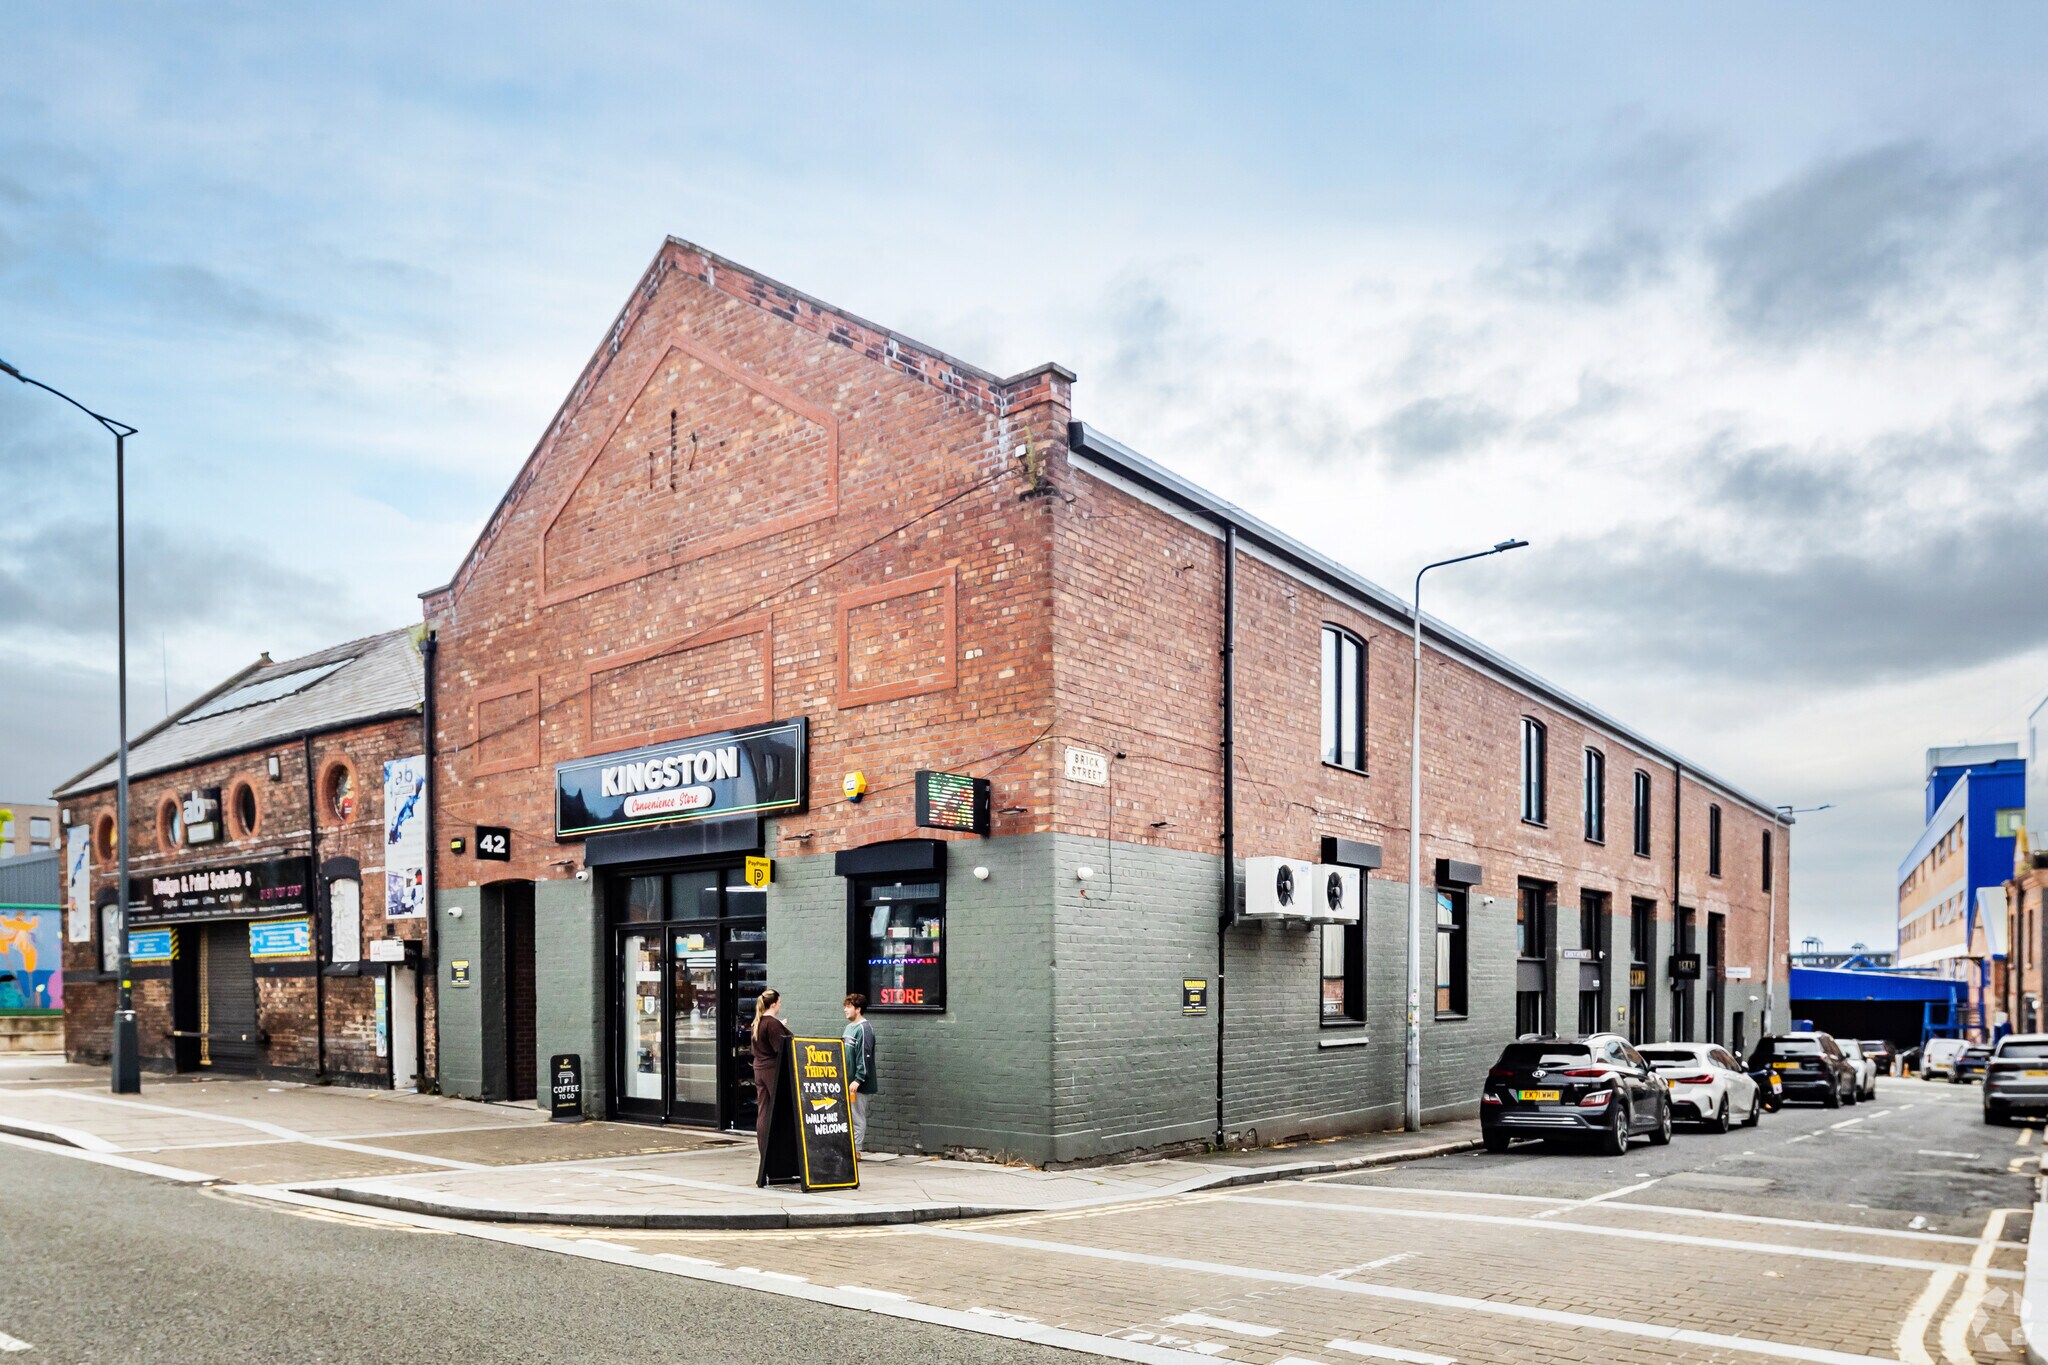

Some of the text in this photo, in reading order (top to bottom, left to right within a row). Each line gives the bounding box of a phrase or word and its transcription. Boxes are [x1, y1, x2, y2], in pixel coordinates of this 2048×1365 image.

[1074, 753, 1099, 768] BRICK
[602, 747, 738, 797] KINGSTON
[1071, 765, 1102, 780] STREET
[183, 789, 205, 825] ab
[631, 792, 700, 814] Convenience Store
[480, 834, 506, 854] 42
[747, 860, 769, 868] PayPoint
[880, 988, 924, 1004] STORE
[804, 1065, 838, 1078] THIEVES
[553, 1084, 580, 1094] COFFEE
[803, 1082, 841, 1094] TATTOO
[566, 1092, 575, 1100] GO
[805, 1112, 838, 1125] WALK-INS
[814, 1122, 848, 1135] WELCOME
